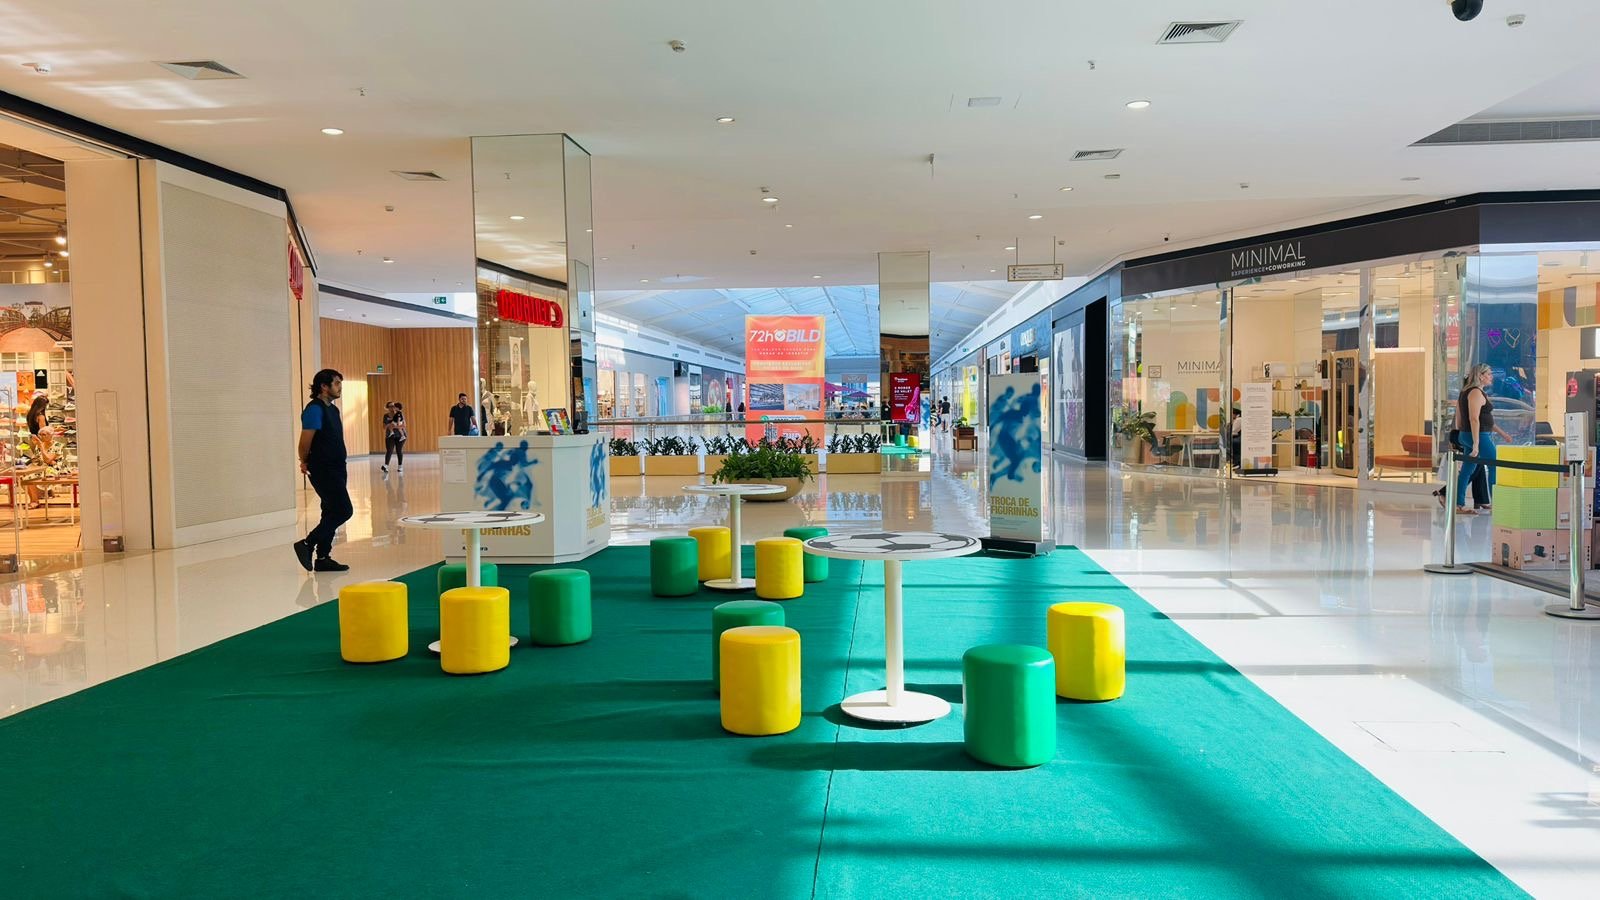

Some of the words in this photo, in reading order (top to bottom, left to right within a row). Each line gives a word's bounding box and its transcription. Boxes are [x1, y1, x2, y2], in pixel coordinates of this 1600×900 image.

[1231, 241, 1306, 270] MINIMAL
[749, 329, 774, 342] 72h
[786, 329, 821, 343] BILD
[1177, 360, 1223, 371] MINIMA
[991, 495, 1016, 506] TROCA
[1018, 497, 1030, 507] DE
[990, 506, 1038, 517] FIGURINHAS
